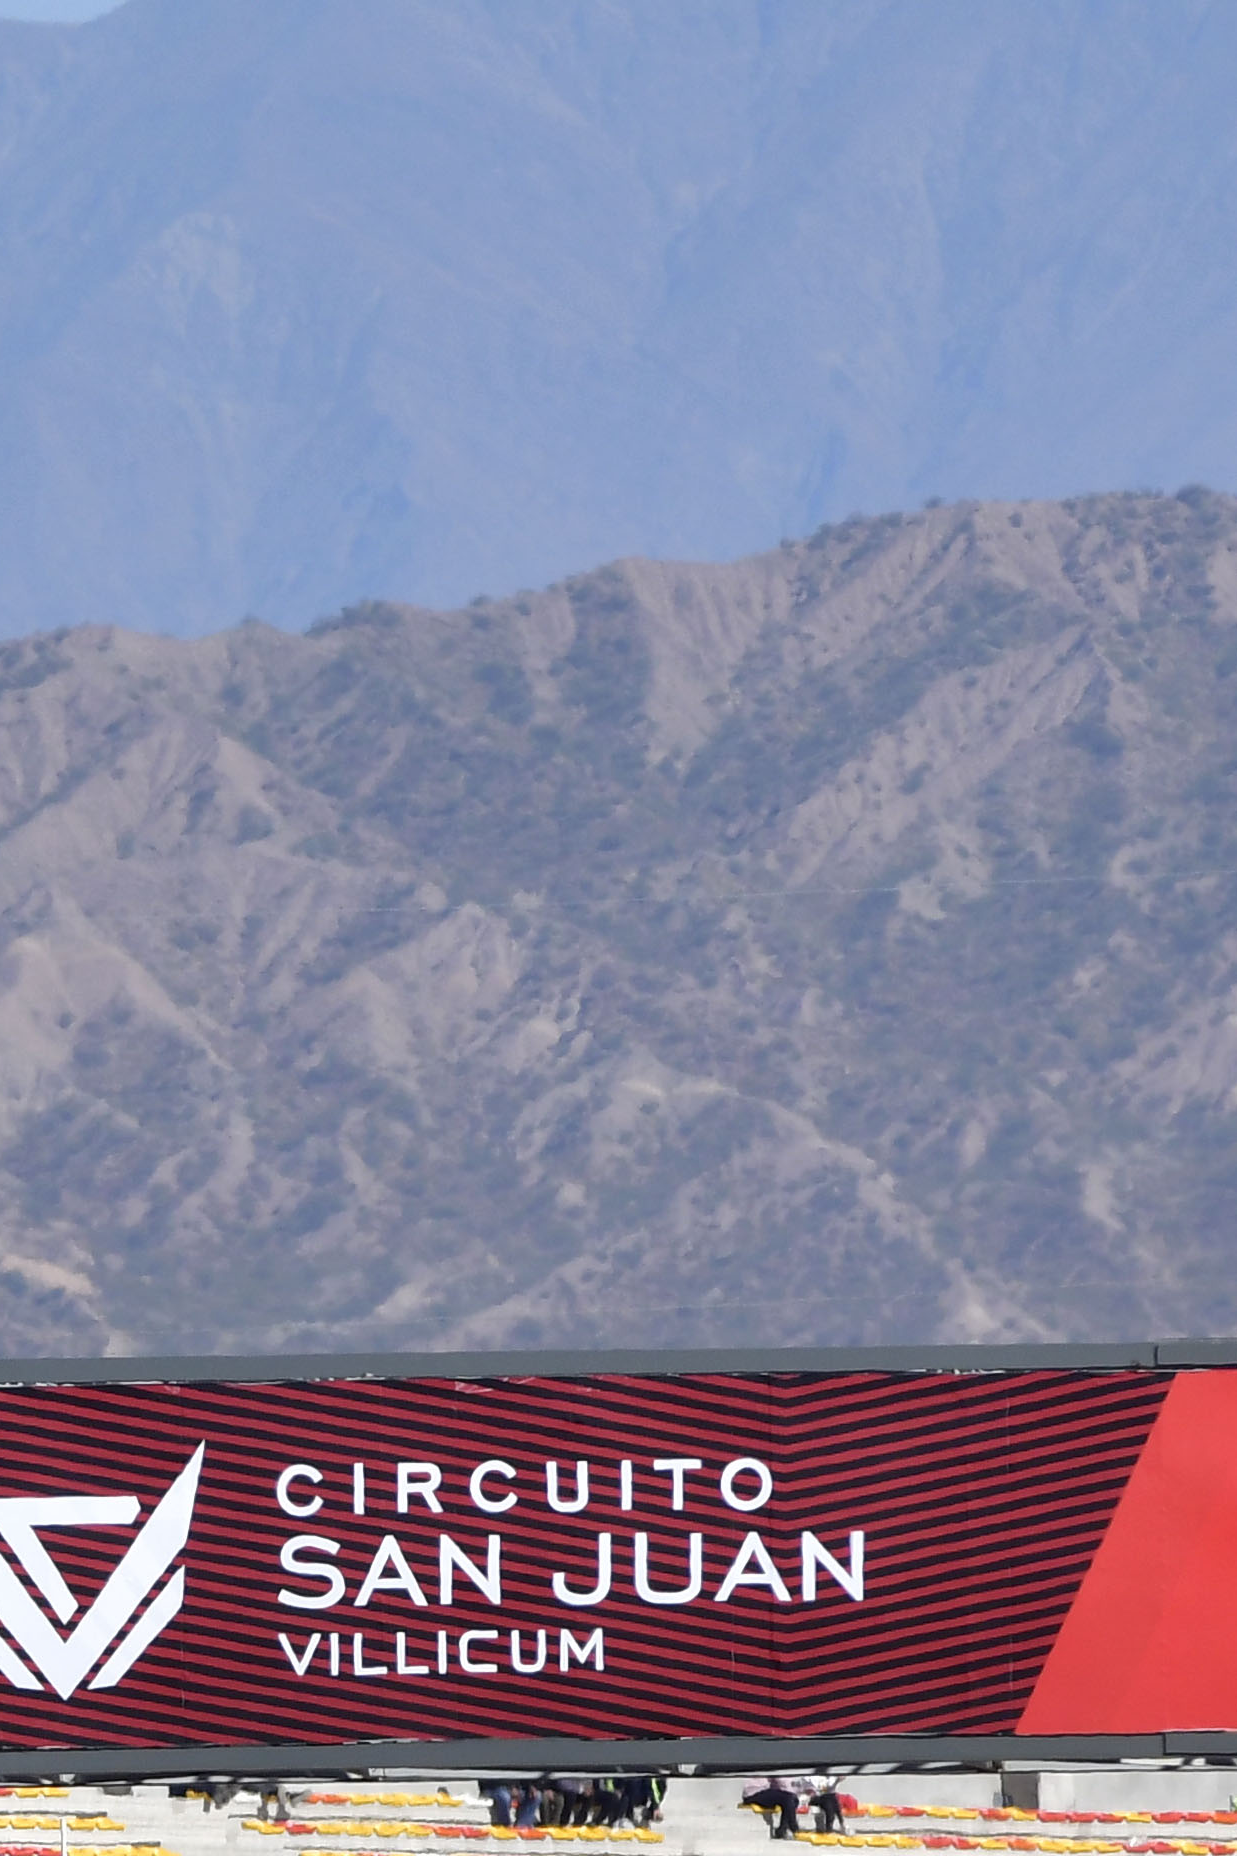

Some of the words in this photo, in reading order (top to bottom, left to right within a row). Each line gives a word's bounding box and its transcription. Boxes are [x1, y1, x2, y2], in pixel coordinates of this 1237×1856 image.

[276, 1457, 773, 1517] CIRCUITO
[277, 1534, 501, 1609] SAN
[552, 1530, 866, 1606] JUAN
[277, 1628, 605, 1677] VILLICUM
